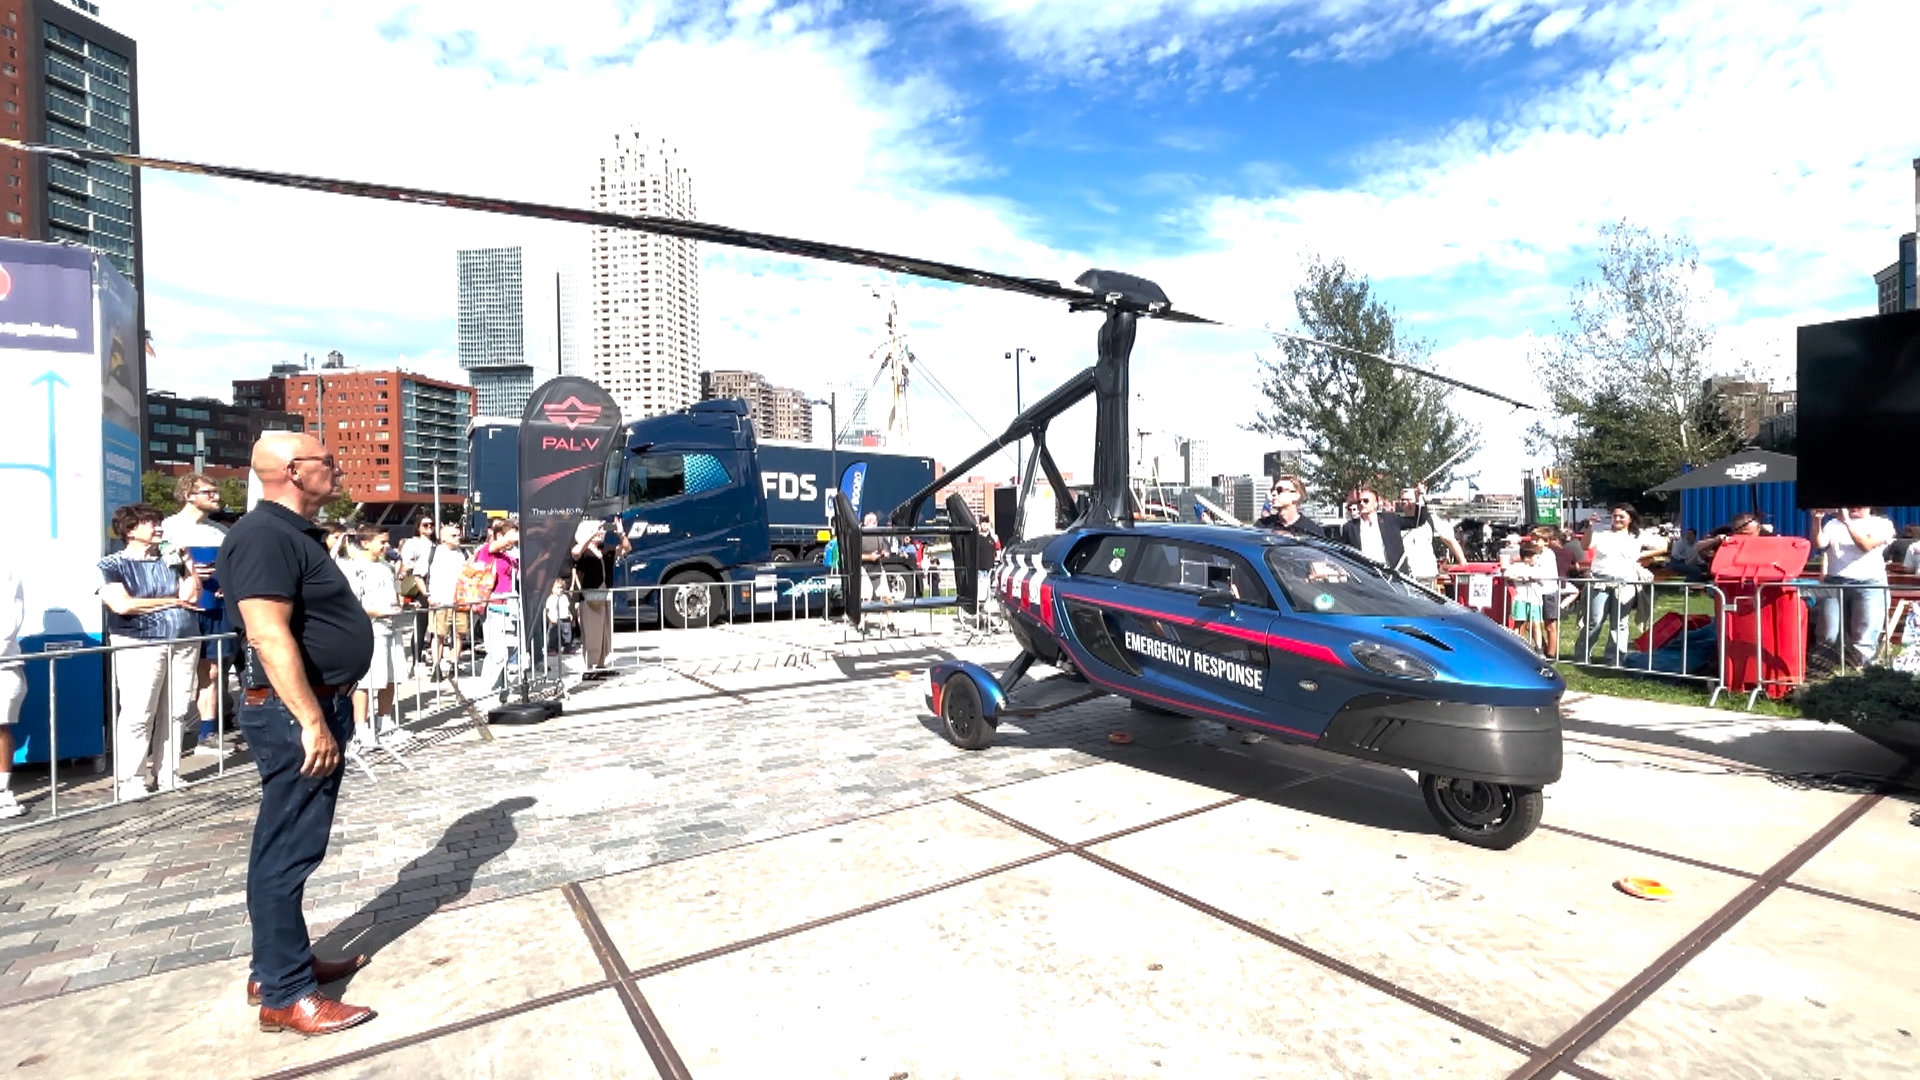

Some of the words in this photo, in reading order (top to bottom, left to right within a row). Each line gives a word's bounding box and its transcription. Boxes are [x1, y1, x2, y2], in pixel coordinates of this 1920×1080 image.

[760, 472, 818, 501] FDS
[1124, 630, 1191, 668] EMERGENCY
[1193, 651, 1264, 691] RESPONSE
